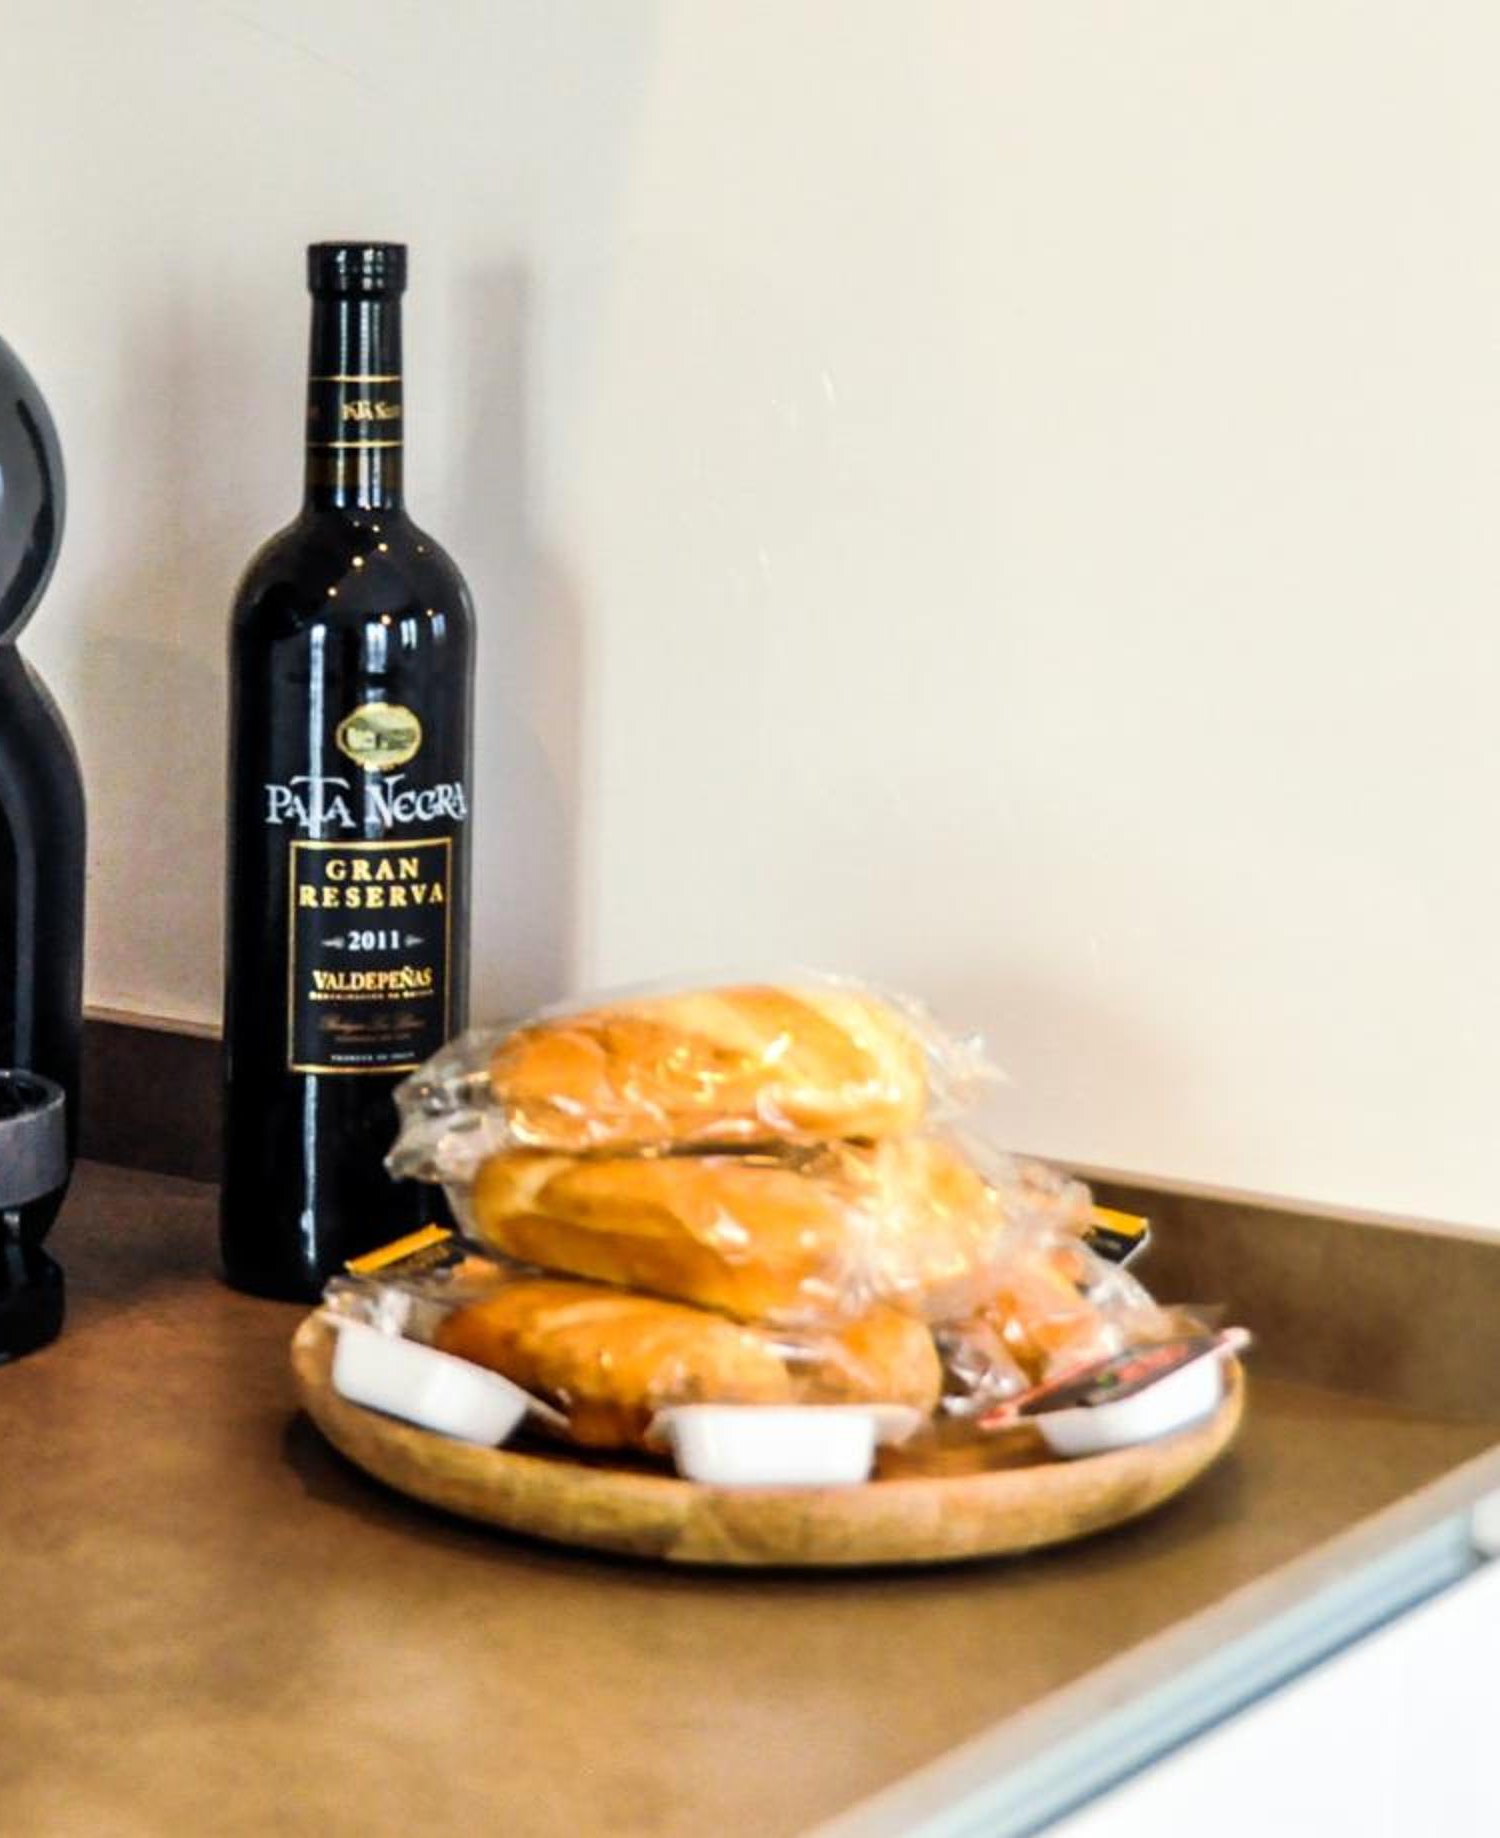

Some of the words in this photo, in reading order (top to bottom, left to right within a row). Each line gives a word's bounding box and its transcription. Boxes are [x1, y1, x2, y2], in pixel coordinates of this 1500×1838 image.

[325, 857, 420, 882] GRAN
[300, 883, 444, 908] RESERVA
[348, 931, 400, 951] 2011
